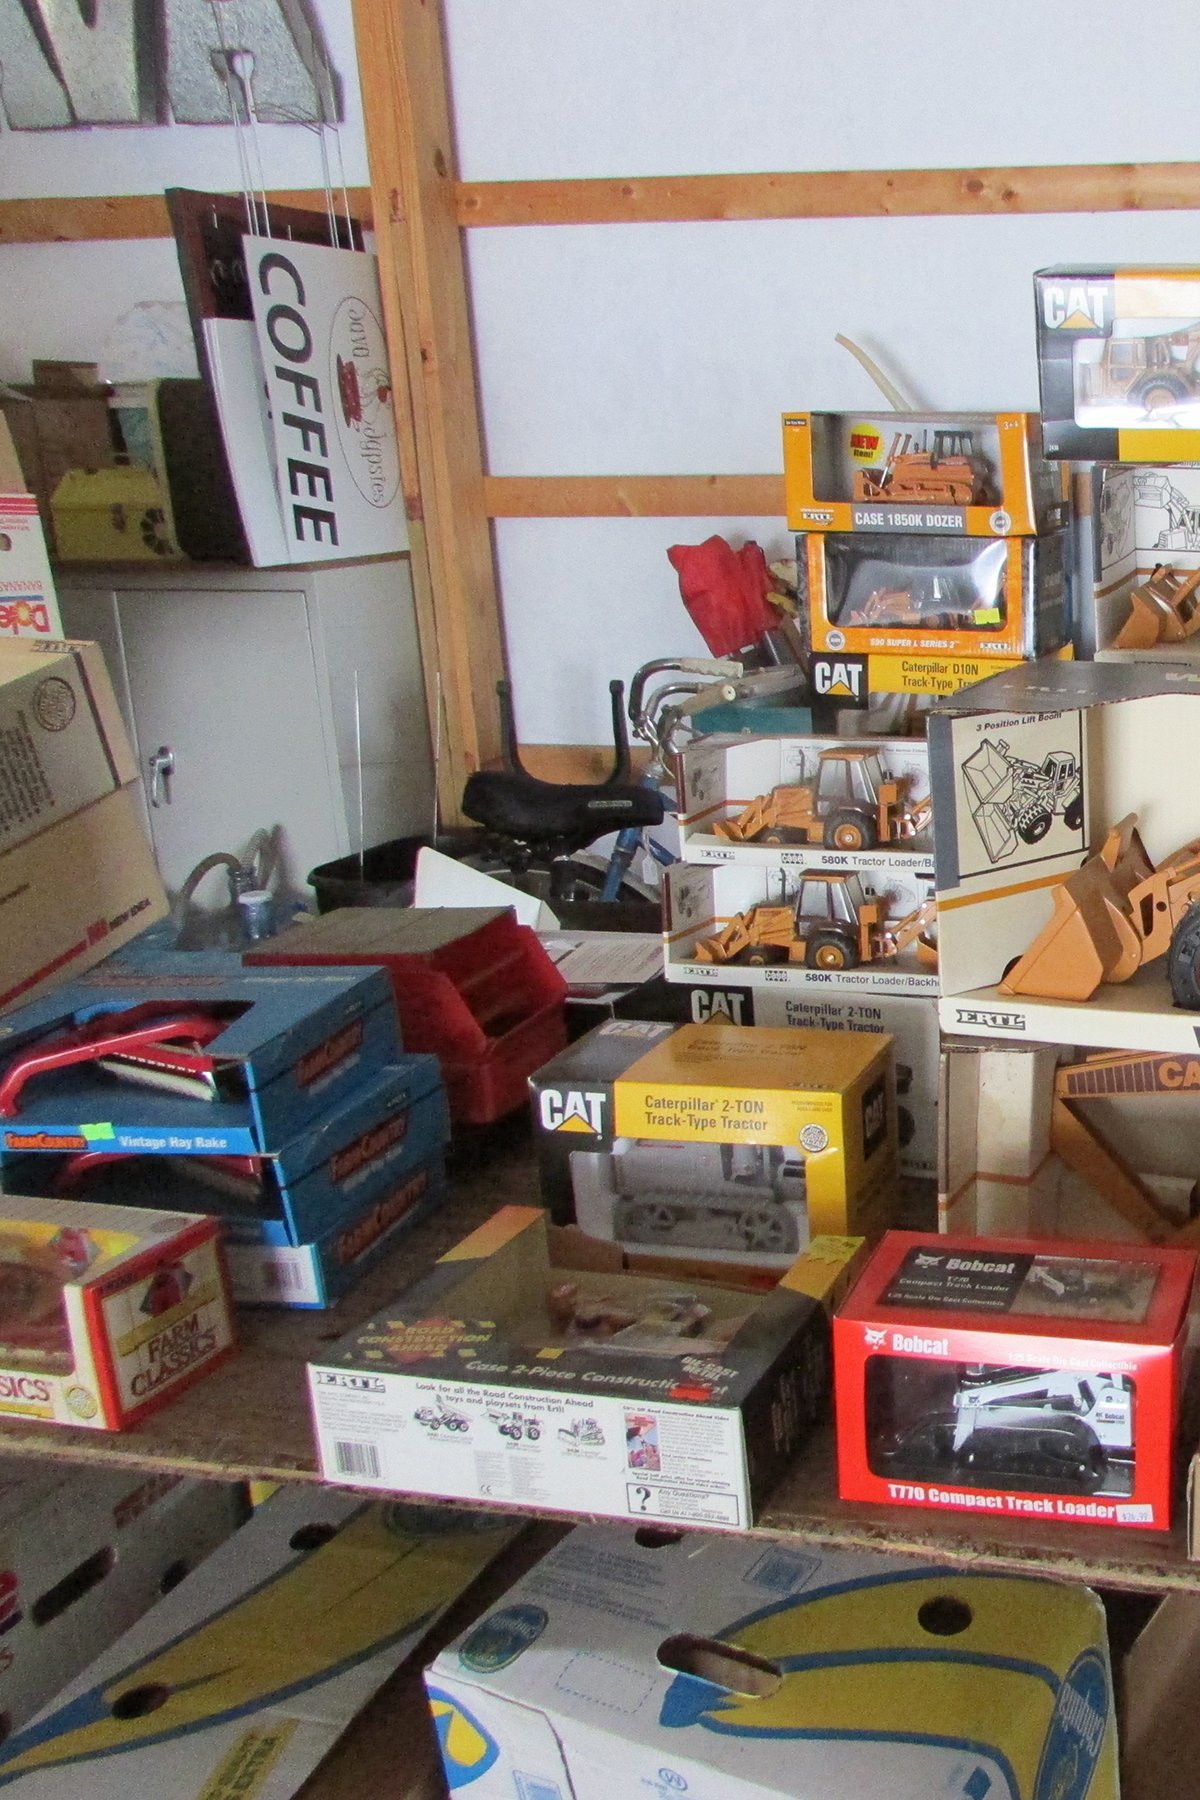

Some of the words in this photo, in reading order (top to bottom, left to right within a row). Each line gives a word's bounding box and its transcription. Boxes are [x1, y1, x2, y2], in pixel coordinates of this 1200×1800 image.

[1043, 286, 1109, 330] CAT
[259, 253, 339, 546] COFFEE
[855, 513, 884, 526] CASE
[889, 514, 923, 527] 1850K
[926, 514, 963, 528] DOZER
[886, 638, 912, 648] SUPER
[920, 639, 948, 648] SERIES
[902, 661, 949, 676] Caterpillar
[953, 663, 979, 676] D10N
[815, 661, 863, 697] CAT
[902, 675, 953, 690] Track-Type
[976, 724, 982, 732] 3
[985, 718, 1020, 732] Position
[1021, 715, 1036, 725] Lift
[1038, 712, 1062, 722] Boom
[821, 856, 848, 865] 580K
[852, 856, 886, 866] Tractor
[805, 973, 832, 983] 580K
[836, 974, 870, 985] Tractor
[691, 989, 745, 1027] CAT
[785, 1000, 842, 1018] Caterpillar
[848, 1007, 882, 1020] 2-TON
[786, 1013, 844, 1031] Track-Type
[847, 1019, 885, 1034] Tractor
[955, 1008, 1027, 1030] ERTL
[540, 1088, 607, 1135] CAT
[645, 1095, 716, 1114] Caterpillar
[722, 1100, 764, 1115] 2-TON
[644, 1112, 717, 1130] Track-Type
[722, 1117, 768, 1132] Tractor
[119, 1135, 166, 1150] Vintage
[169, 1136, 193, 1150] Hay
[195, 1136, 228, 1149] Rake
[945, 1257, 1015, 1275] Bobcat
[899, 1278, 943, 1287] Compact
[946, 1281, 973, 1290] Track
[975, 1283, 1010, 1292] Loader
[148, 1312, 200, 1364] FARM
[892, 1332, 948, 1356] Bobcat
[130, 1330, 218, 1397] CLASSICS
[465, 1359, 508, 1373] Case
[511, 1363, 576, 1381] 2-Piece
[1089, 1358, 1138, 1371] Collectible
[416, 1382, 436, 1392] Look
[439, 1383, 451, 1393] for
[454, 1386, 465, 1395] all
[467, 1387, 481, 1397] the
[483, 1389, 506, 1399] Road
[508, 1391, 563, 1405] Construction
[565, 1398, 595, 1408] Ahead
[445, 1394, 464, 1404] toys
[466, 1396, 484, 1406] and
[485, 1398, 522, 1411] playsets
[523, 1402, 545, 1412] from
[888, 1483, 925, 1502] T770
[928, 1487, 1003, 1510] Compact
[1007, 1494, 1053, 1514] Track
[1056, 1500, 1115, 1519] Loader
